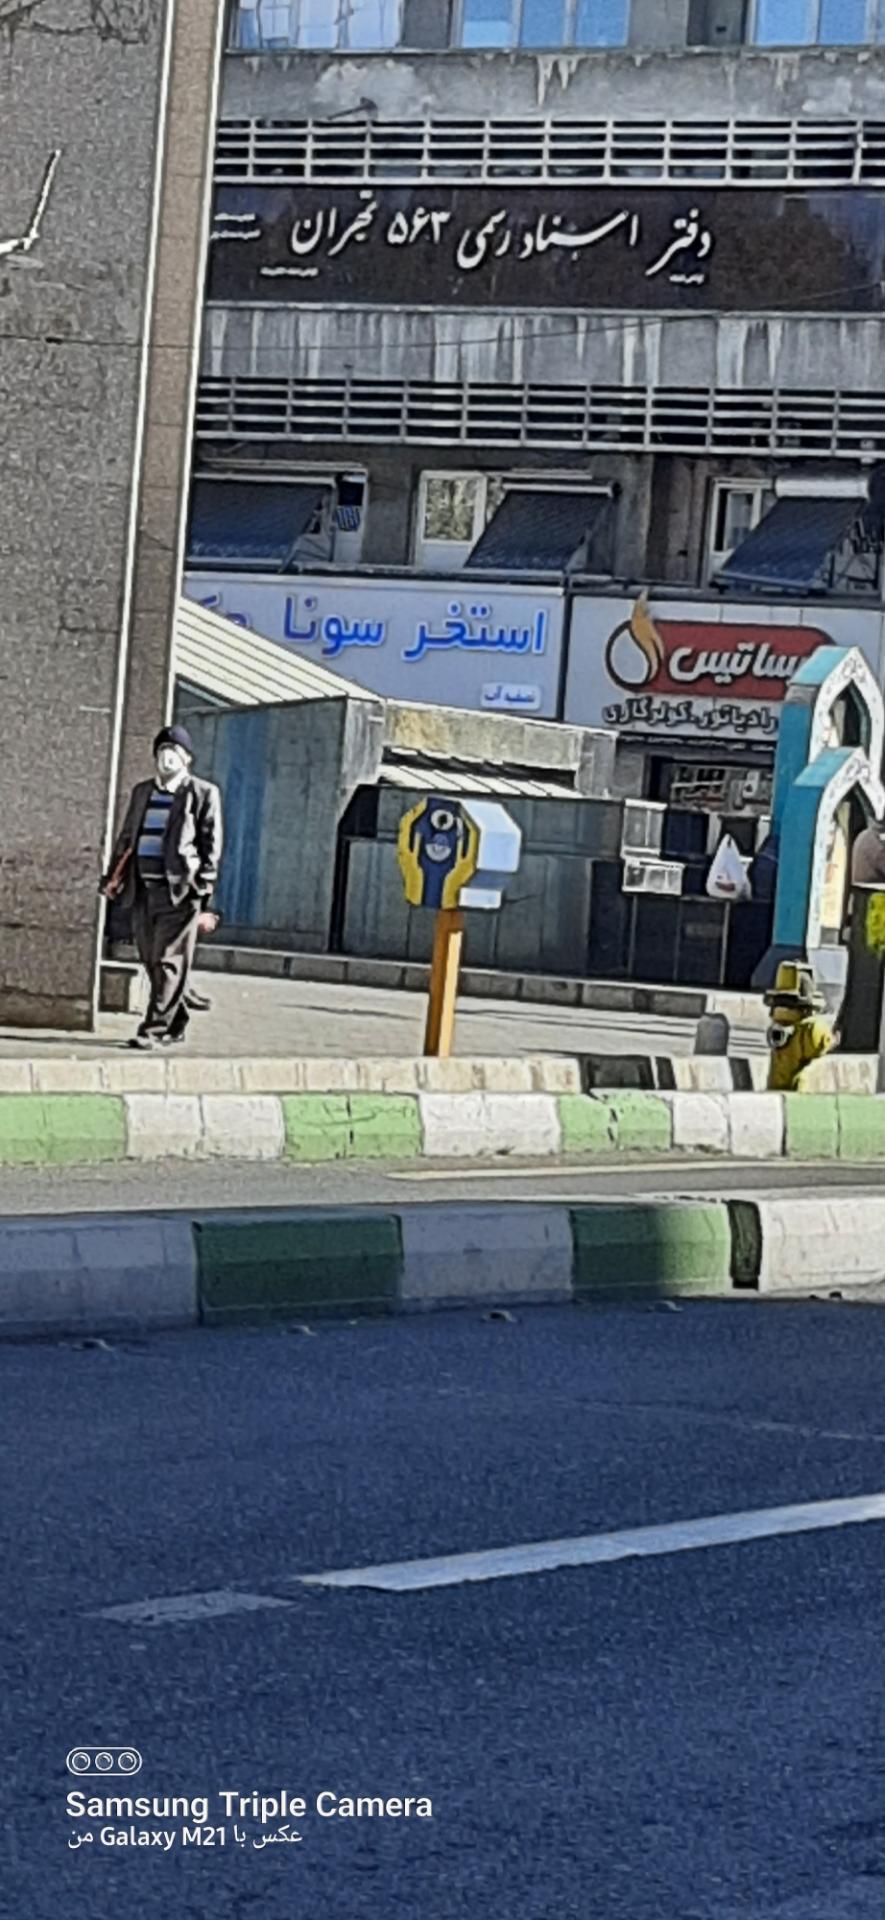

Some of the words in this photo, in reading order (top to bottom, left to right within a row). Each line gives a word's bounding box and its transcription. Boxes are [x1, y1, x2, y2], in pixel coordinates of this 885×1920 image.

[290, 189, 379, 257] تهران
[387, 206, 452, 245] ۵۶۳
[456, 208, 512, 270] رسمی
[518, 210, 639, 260] اسناد
[645, 207, 712, 276] دفتر
[283, 596, 384, 656] سونا
[402, 602, 546, 660] استخر
